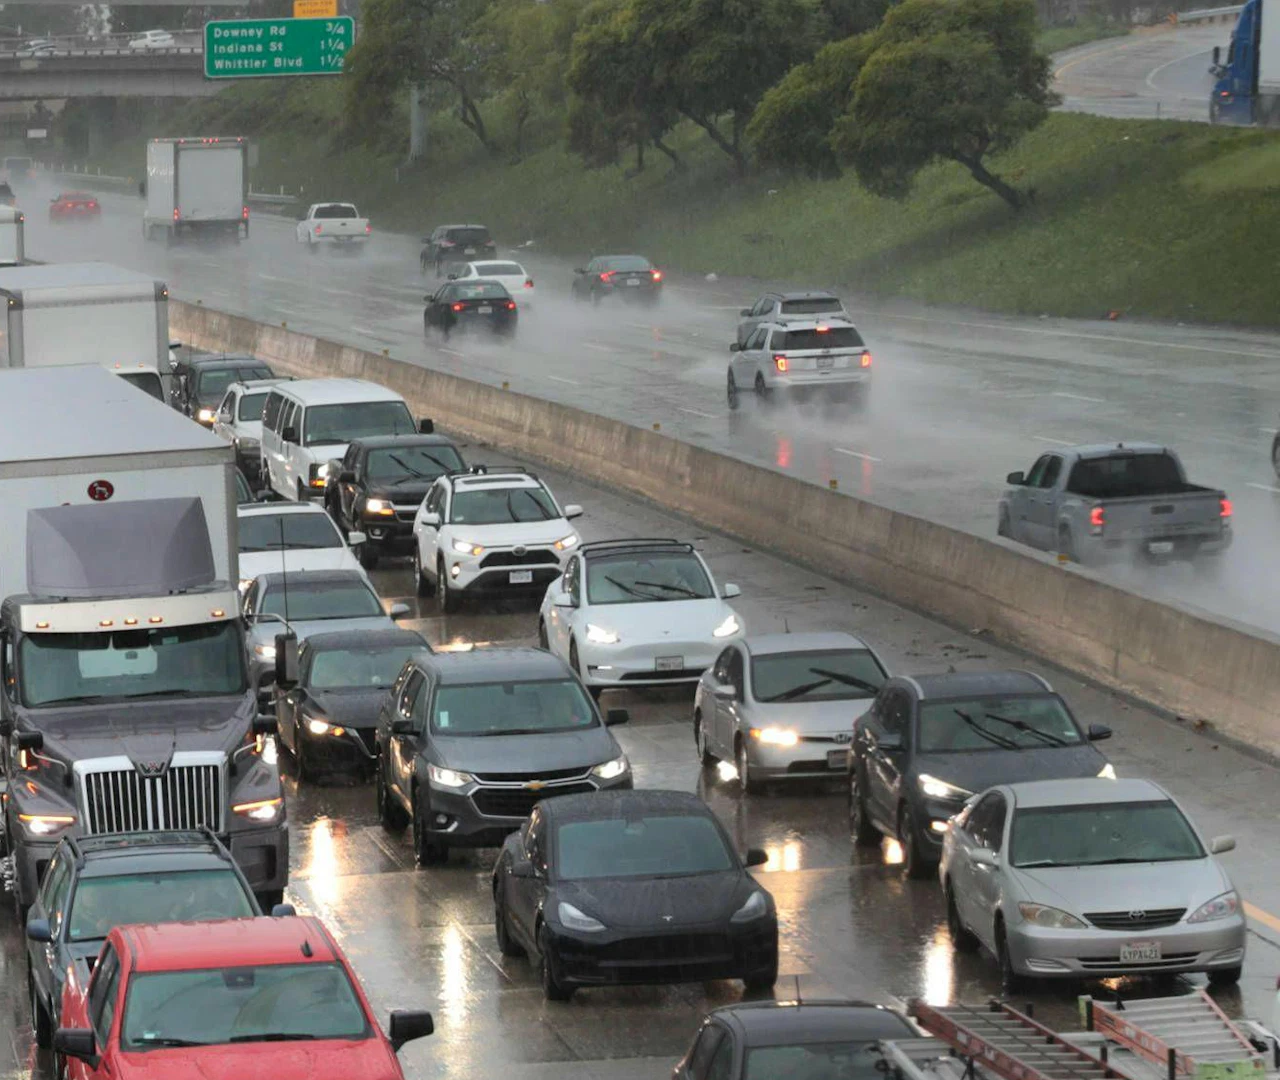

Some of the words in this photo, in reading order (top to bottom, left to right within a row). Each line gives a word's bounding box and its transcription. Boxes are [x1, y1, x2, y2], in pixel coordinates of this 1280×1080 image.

[214, 27, 263, 38] Downey
[269, 26, 286, 36] Rd
[214, 43, 263, 54] Indiana
[269, 42, 283, 52] St
[214, 58, 267, 69] Whittier
[274, 57, 303, 68] Blvd
